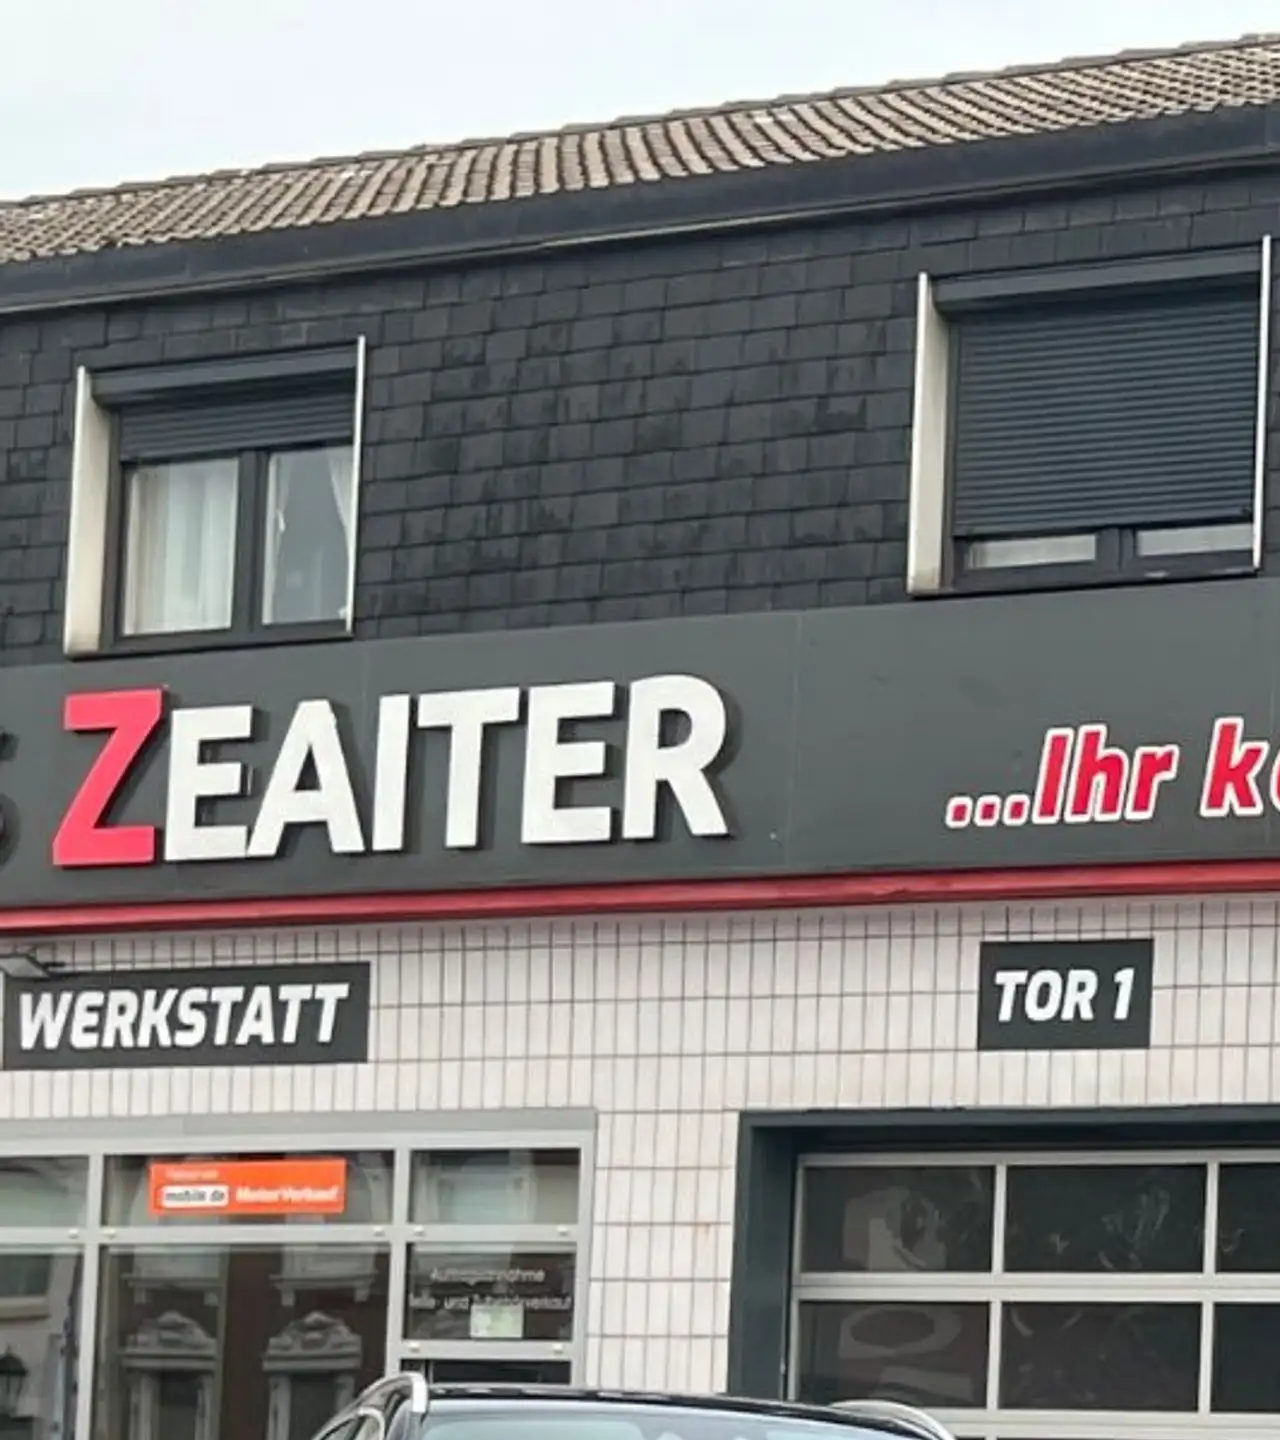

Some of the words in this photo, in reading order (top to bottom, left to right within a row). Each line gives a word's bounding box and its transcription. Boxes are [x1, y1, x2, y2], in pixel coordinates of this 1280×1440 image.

[53, 673, 730, 867] ZEAITER
[18, 982, 350, 1051] WERKSTATT
[994, 969, 1096, 1022] TOR
[1111, 967, 1135, 1020] 1
